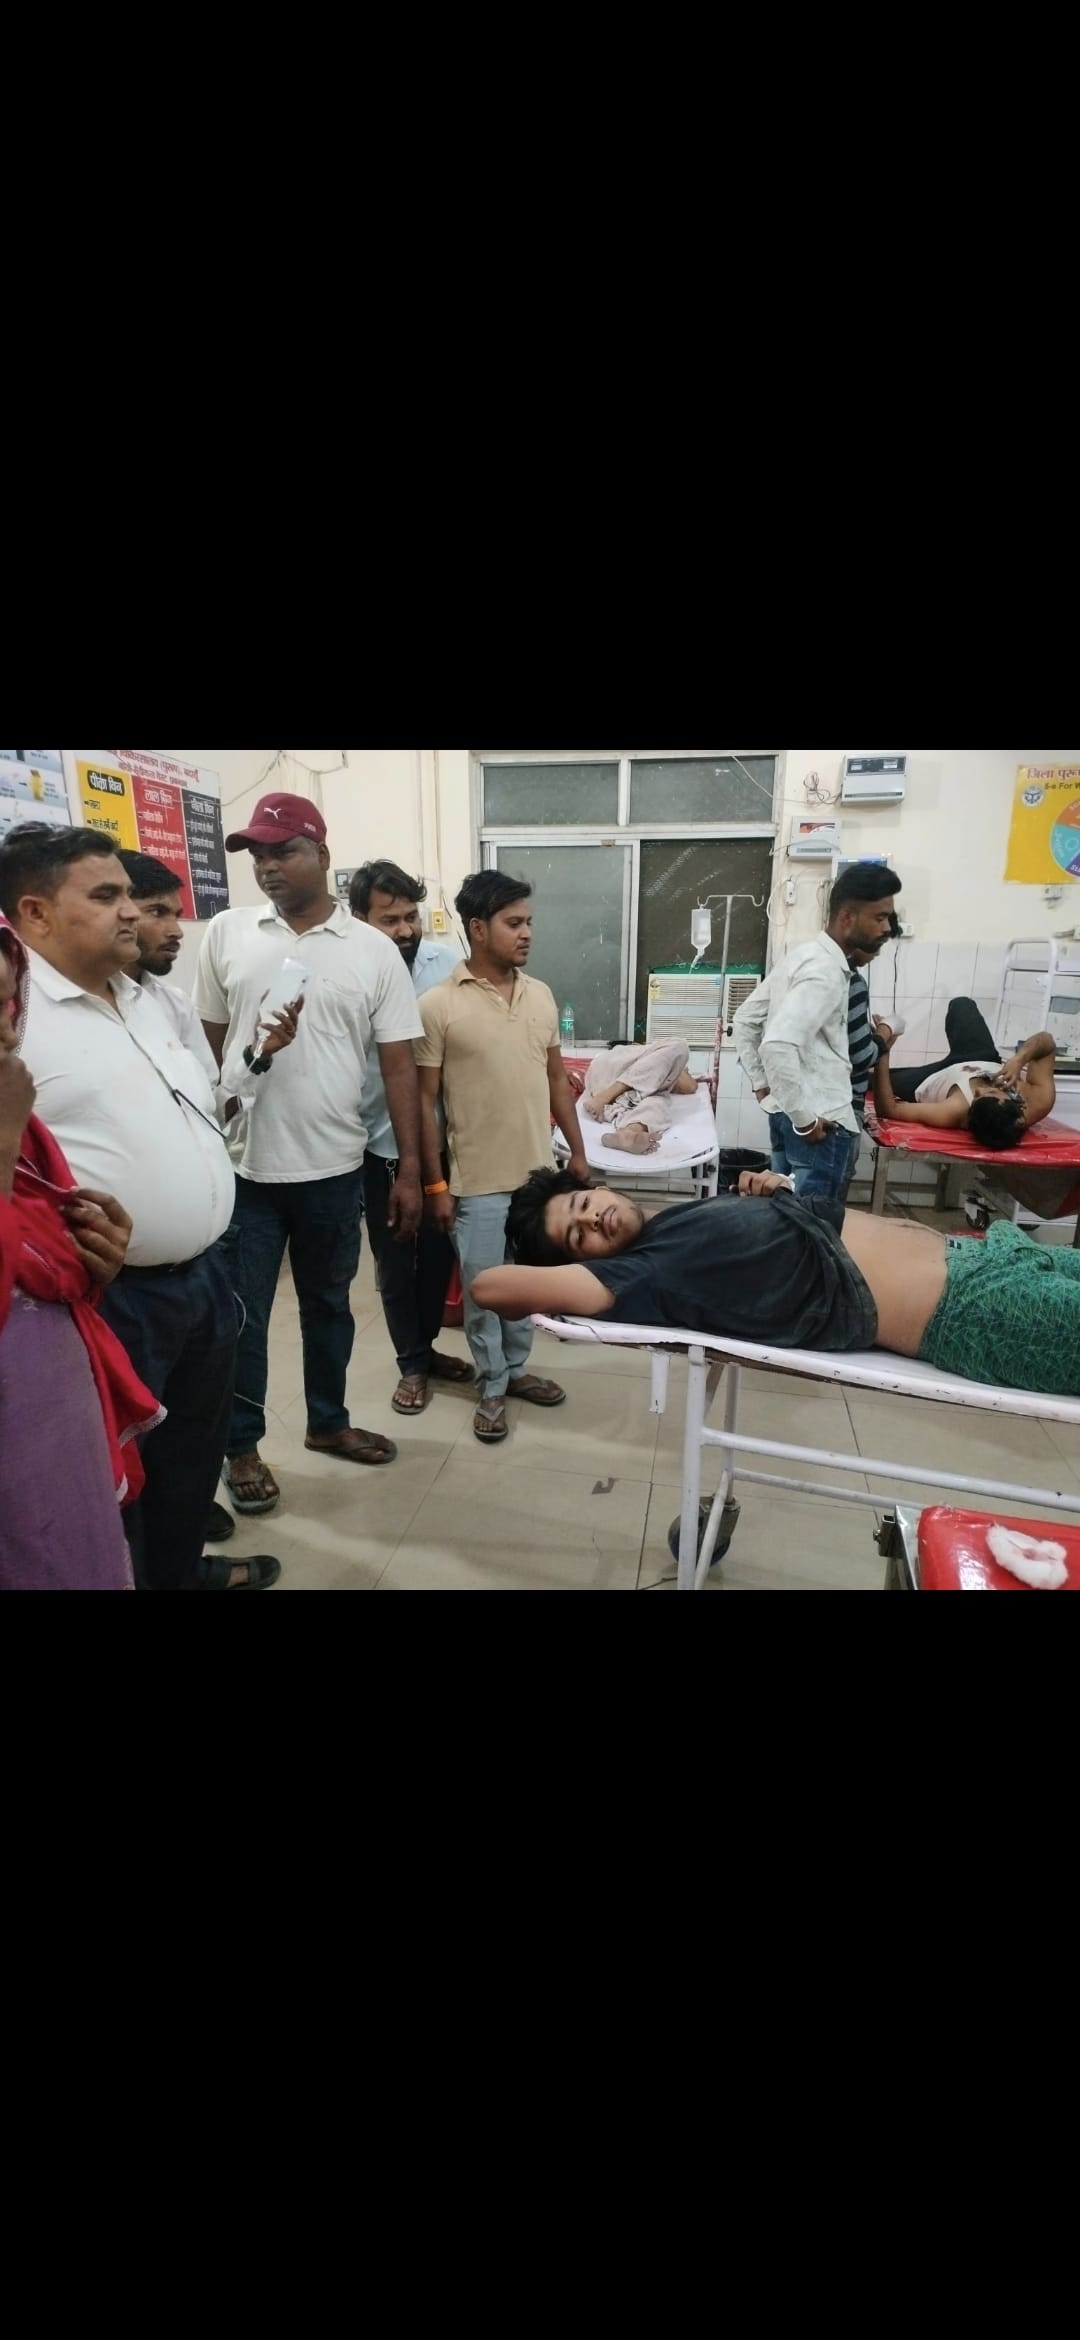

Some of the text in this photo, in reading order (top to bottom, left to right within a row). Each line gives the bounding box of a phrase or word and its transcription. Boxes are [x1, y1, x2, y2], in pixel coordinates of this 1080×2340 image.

[1027, 767, 1053, 779] जिला
[1059, 782, 1073, 790] For
[144, 789, 160, 803] लाल
